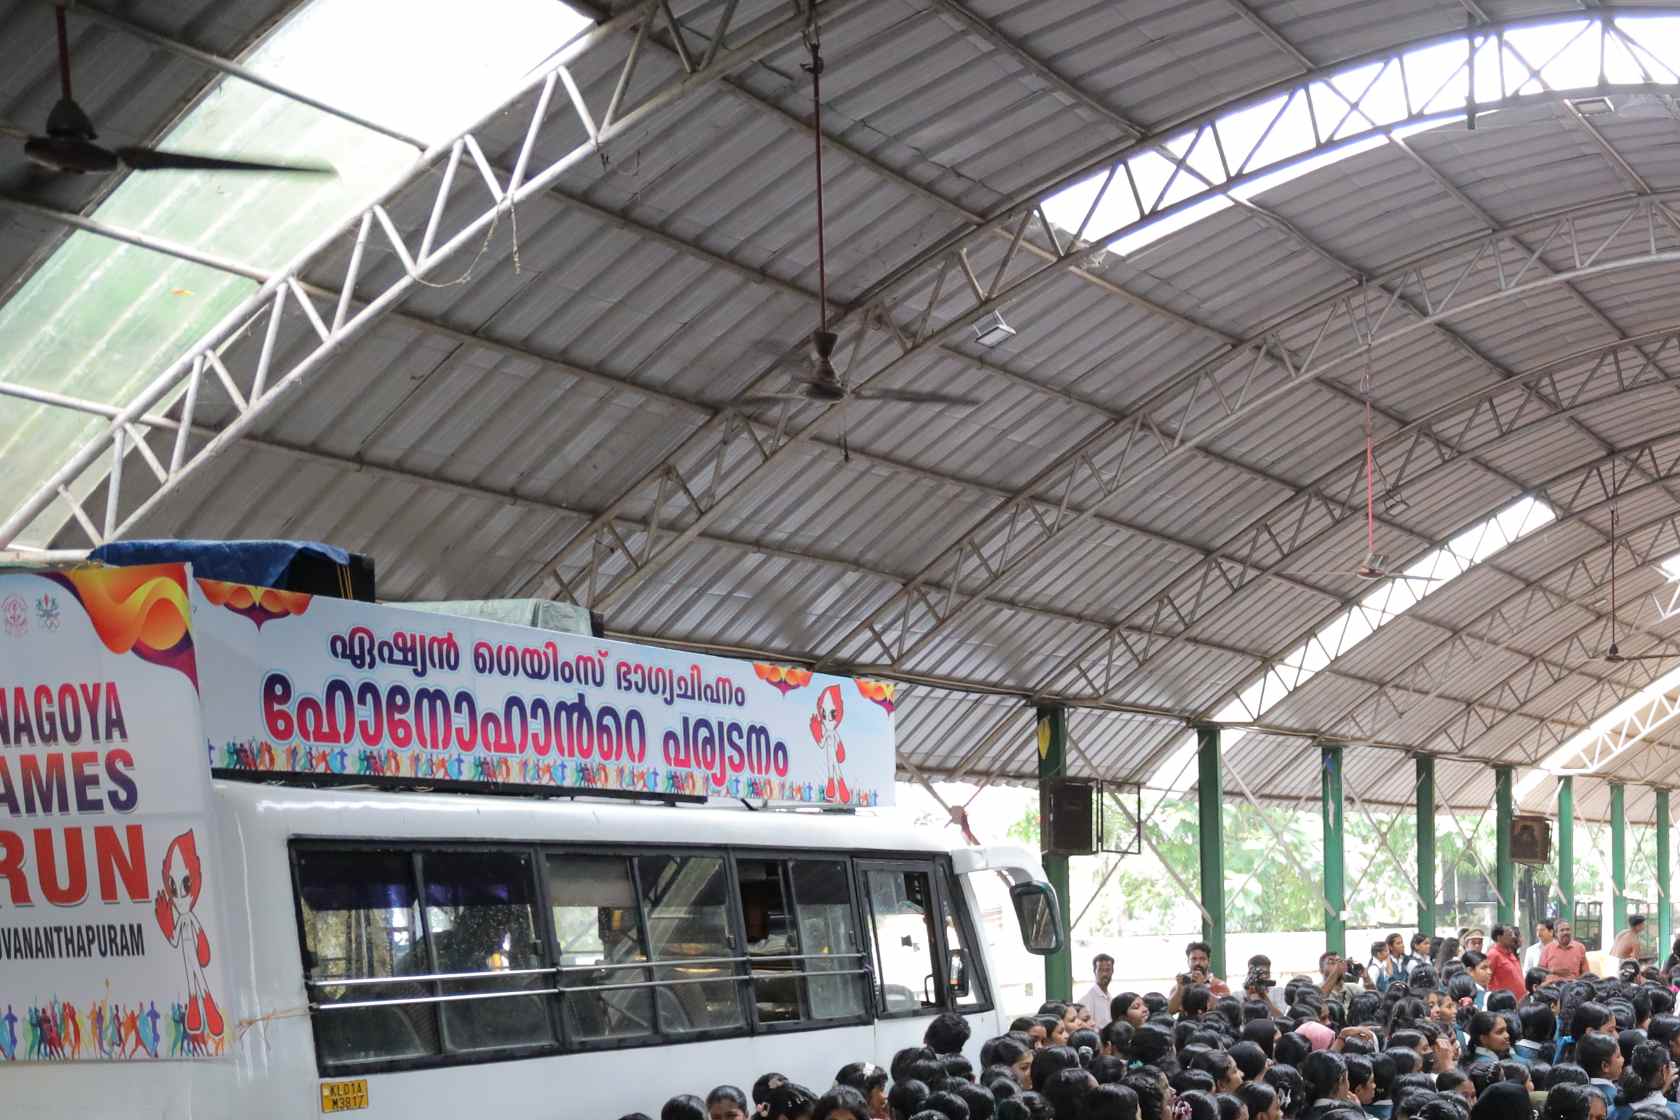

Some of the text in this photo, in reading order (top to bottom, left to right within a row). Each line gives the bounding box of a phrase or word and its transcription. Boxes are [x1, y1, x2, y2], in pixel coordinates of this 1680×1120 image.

[330, 626, 461, 678] ഏഷ്യൻ
[473, 640, 608, 688] ഗെയിംസ്
[662, 715, 789, 787] പര്യടനം
[0, 824, 151, 906] RUN
[0, 923, 145, 960] VANANTHAPURAM
